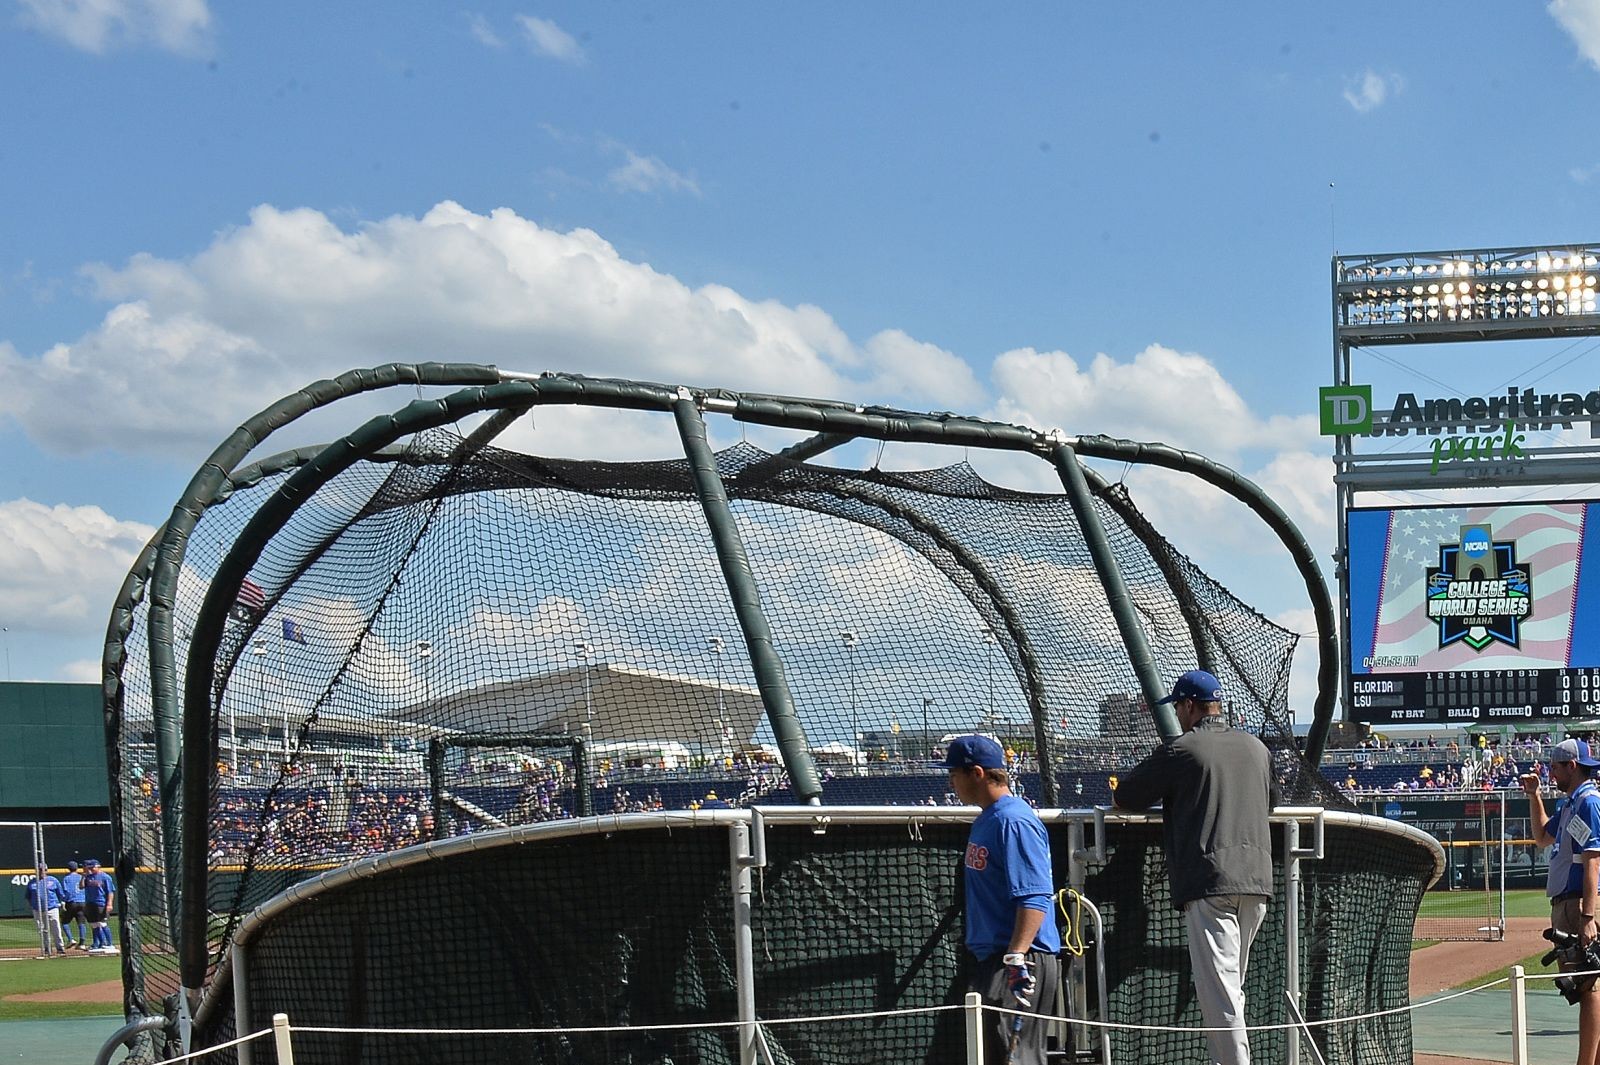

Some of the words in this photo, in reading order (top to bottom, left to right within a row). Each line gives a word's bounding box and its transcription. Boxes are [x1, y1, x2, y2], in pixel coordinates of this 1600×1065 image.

[1325, 395, 1367, 425] TD
[1430, 420, 1526, 476] park
[1464, 466, 1526, 478] OMAHA
[1464, 541, 1488, 552] NCAA
[1448, 580, 1507, 598] COLLEGE
[1429, 599, 1477, 617] WORLD
[1477, 598, 1529, 615] SERIES
[1463, 617, 1493, 625] OMAHA
[1363, 656, 1402, 667] 04:34:59
[1403, 655, 1418, 666] PM
[1354, 681, 1393, 693] FLORIDA
[1563, 676, 1570, 689] 0
[1581, 675, 1588, 688] 0
[1593, 675, 1600, 688] 0
[1354, 696, 1371, 707] LSU
[1563, 690, 1570, 703] 0
[1581, 690, 1588, 702] 0
[1593, 690, 1600, 702] 0
[1391, 710, 1404, 718] AT
[1406, 709, 1425, 718] BAT
[1448, 709, 1472, 717] BALL
[1472, 707, 1480, 718] 0
[1489, 707, 1525, 716] STRIKE
[1524, 705, 1532, 716] 0
[1542, 707, 1562, 715] OUT
[1562, 705, 1569, 716] 0
[1435, 821, 1457, 830] SHOW
[1464, 821, 1480, 829] DIRT
[11, 874, 36, 886] 40
